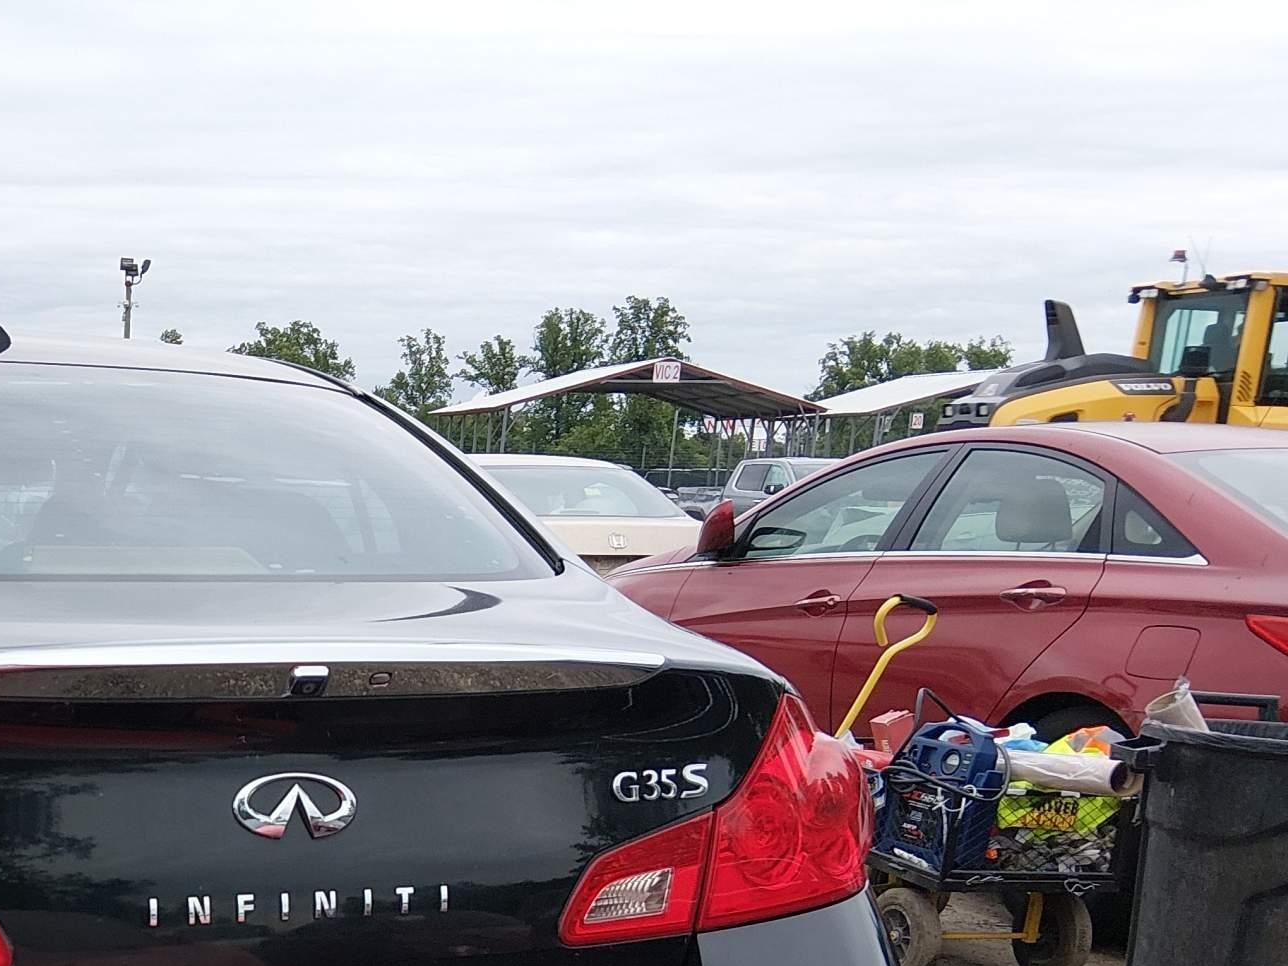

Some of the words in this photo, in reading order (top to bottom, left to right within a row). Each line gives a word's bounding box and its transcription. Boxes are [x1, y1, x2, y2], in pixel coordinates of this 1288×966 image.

[655, 364, 670, 380] VIC
[673, 364, 680, 380] 2
[1116, 383, 1172, 391] VOLVO
[612, 763, 709, 802] G35S
[148, 884, 449, 926] INFINITI
